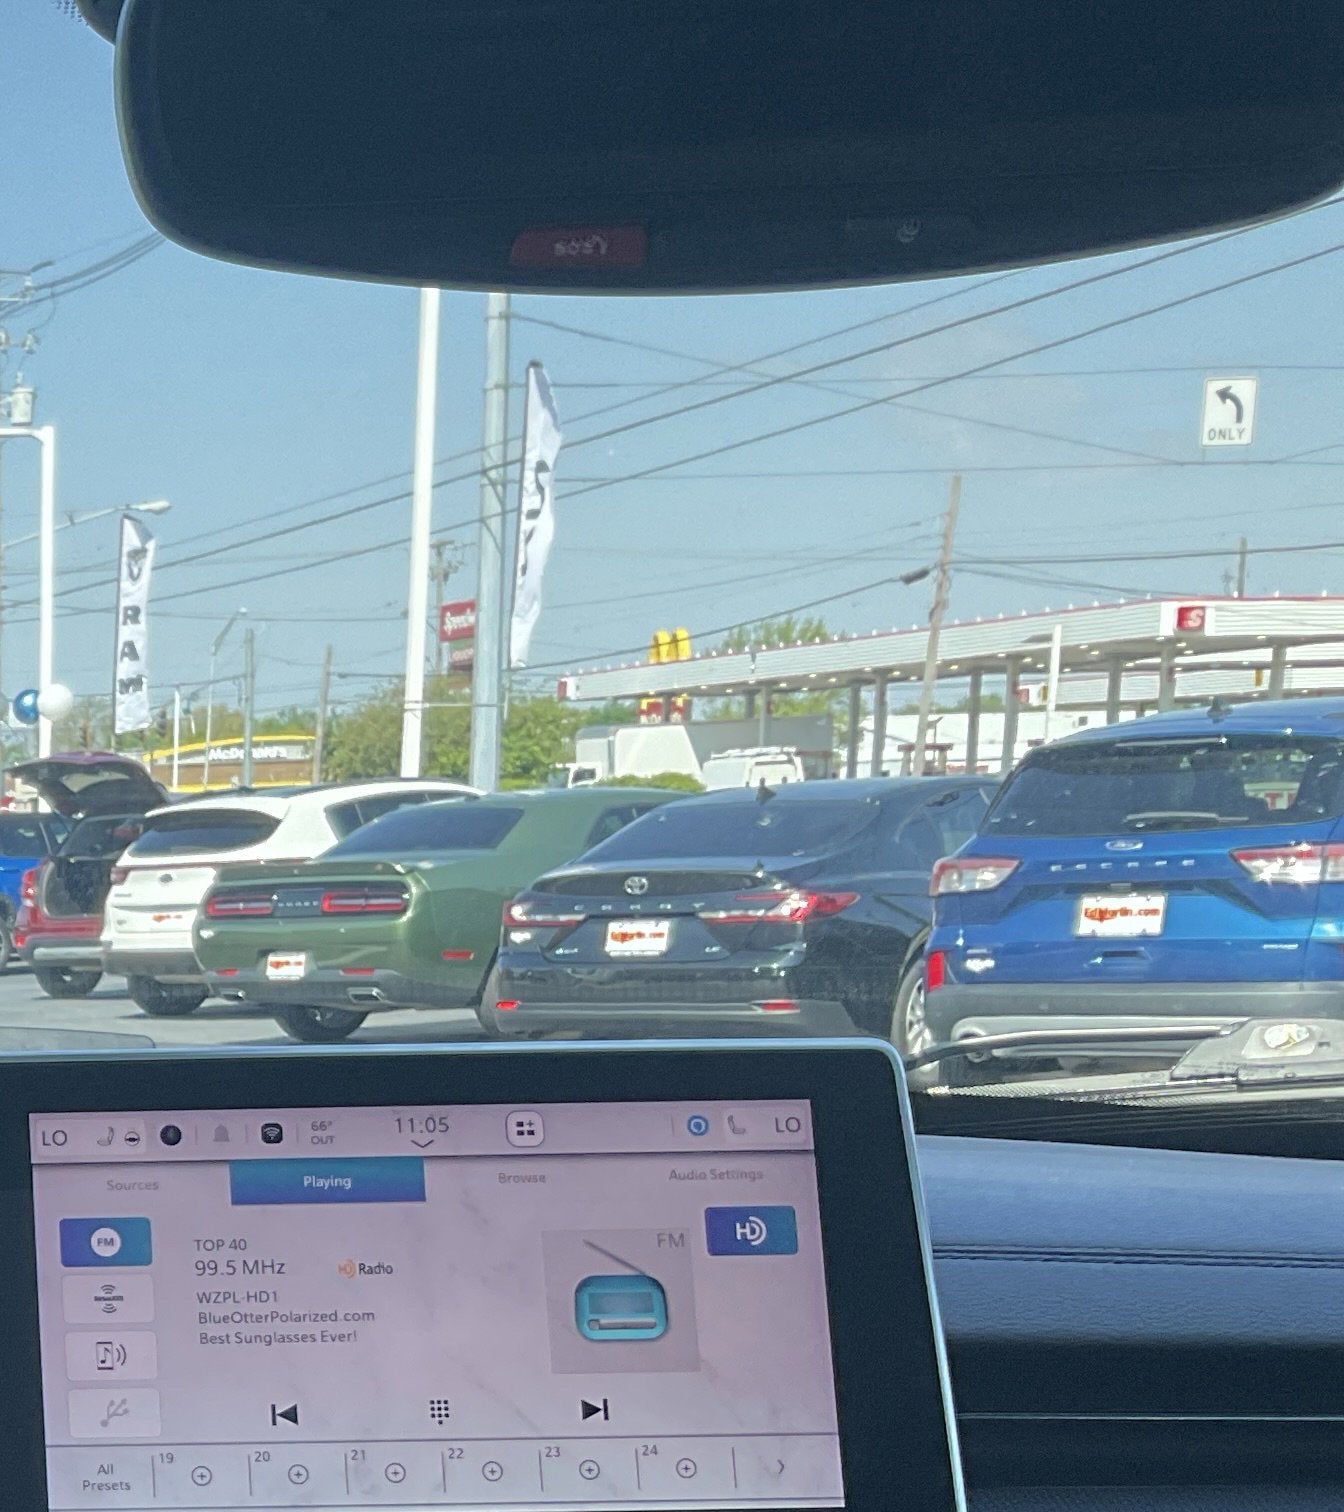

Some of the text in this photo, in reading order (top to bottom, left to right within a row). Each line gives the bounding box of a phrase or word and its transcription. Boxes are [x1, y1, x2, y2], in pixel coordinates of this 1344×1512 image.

[1207, 428, 1245, 441] ONLY
[395, 1117, 450, 1134] 11:05
[775, 1117, 801, 1134] LO
[41, 1130, 68, 1147] LO
[311, 1135, 335, 1145] OUT
[498, 1172, 546, 1184] Browse
[669, 1168, 764, 1183] Audio Settings
[107, 1179, 159, 1191] Sources
[303, 1175, 352, 1190] Playing
[97, 1237, 115, 1247] FM
[194, 1238, 247, 1251] TOP 40
[657, 1232, 685, 1248] FM
[194, 1258, 286, 1276] 99.5 MHz
[358, 1262, 394, 1275] Radio
[197, 1290, 278, 1304] WZPL-HD1
[198, 1309, 375, 1325] BlueOtterPolarized.com
[199, 1330, 358, 1347] Best Sunglasses Ever!
[254, 1451, 271, 1462] 20
[350, 1450, 366, 1461] 21
[448, 1448, 464, 1459] 22
[545, 1446, 561, 1457] 23
[641, 1445, 658, 1456] 24
[159, 1453, 174, 1463] 19
[97, 1463, 113, 1476] All
[83, 1479, 131, 1493] Presets
